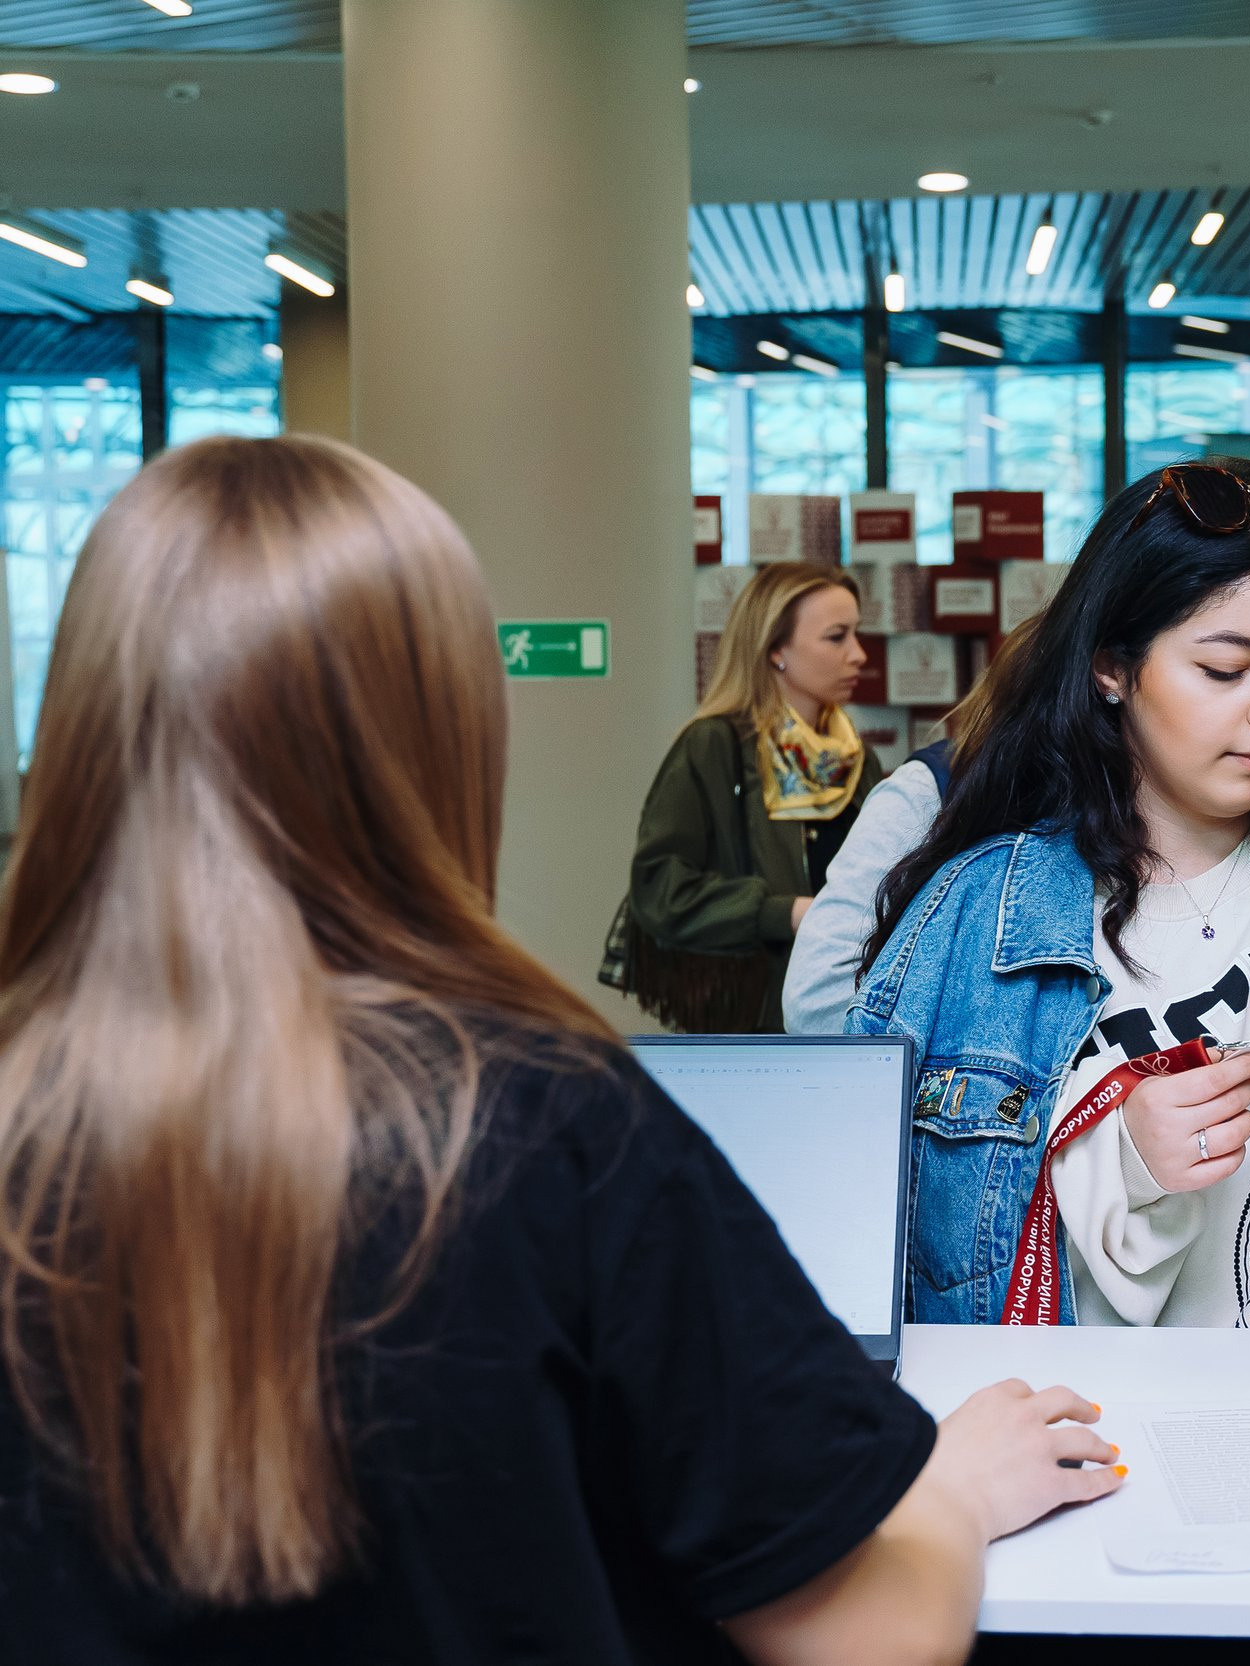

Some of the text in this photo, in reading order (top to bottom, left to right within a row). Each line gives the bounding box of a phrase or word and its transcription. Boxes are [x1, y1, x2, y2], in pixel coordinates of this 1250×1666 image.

[1050, 1080, 1123, 1149] ФОРУМ 2023
[1013, 1252, 1036, 1309] ФОРУМ
[1037, 1244, 1053, 1326] ЛТИЙСКИЙ
[1009, 1309, 1023, 1326] 20
